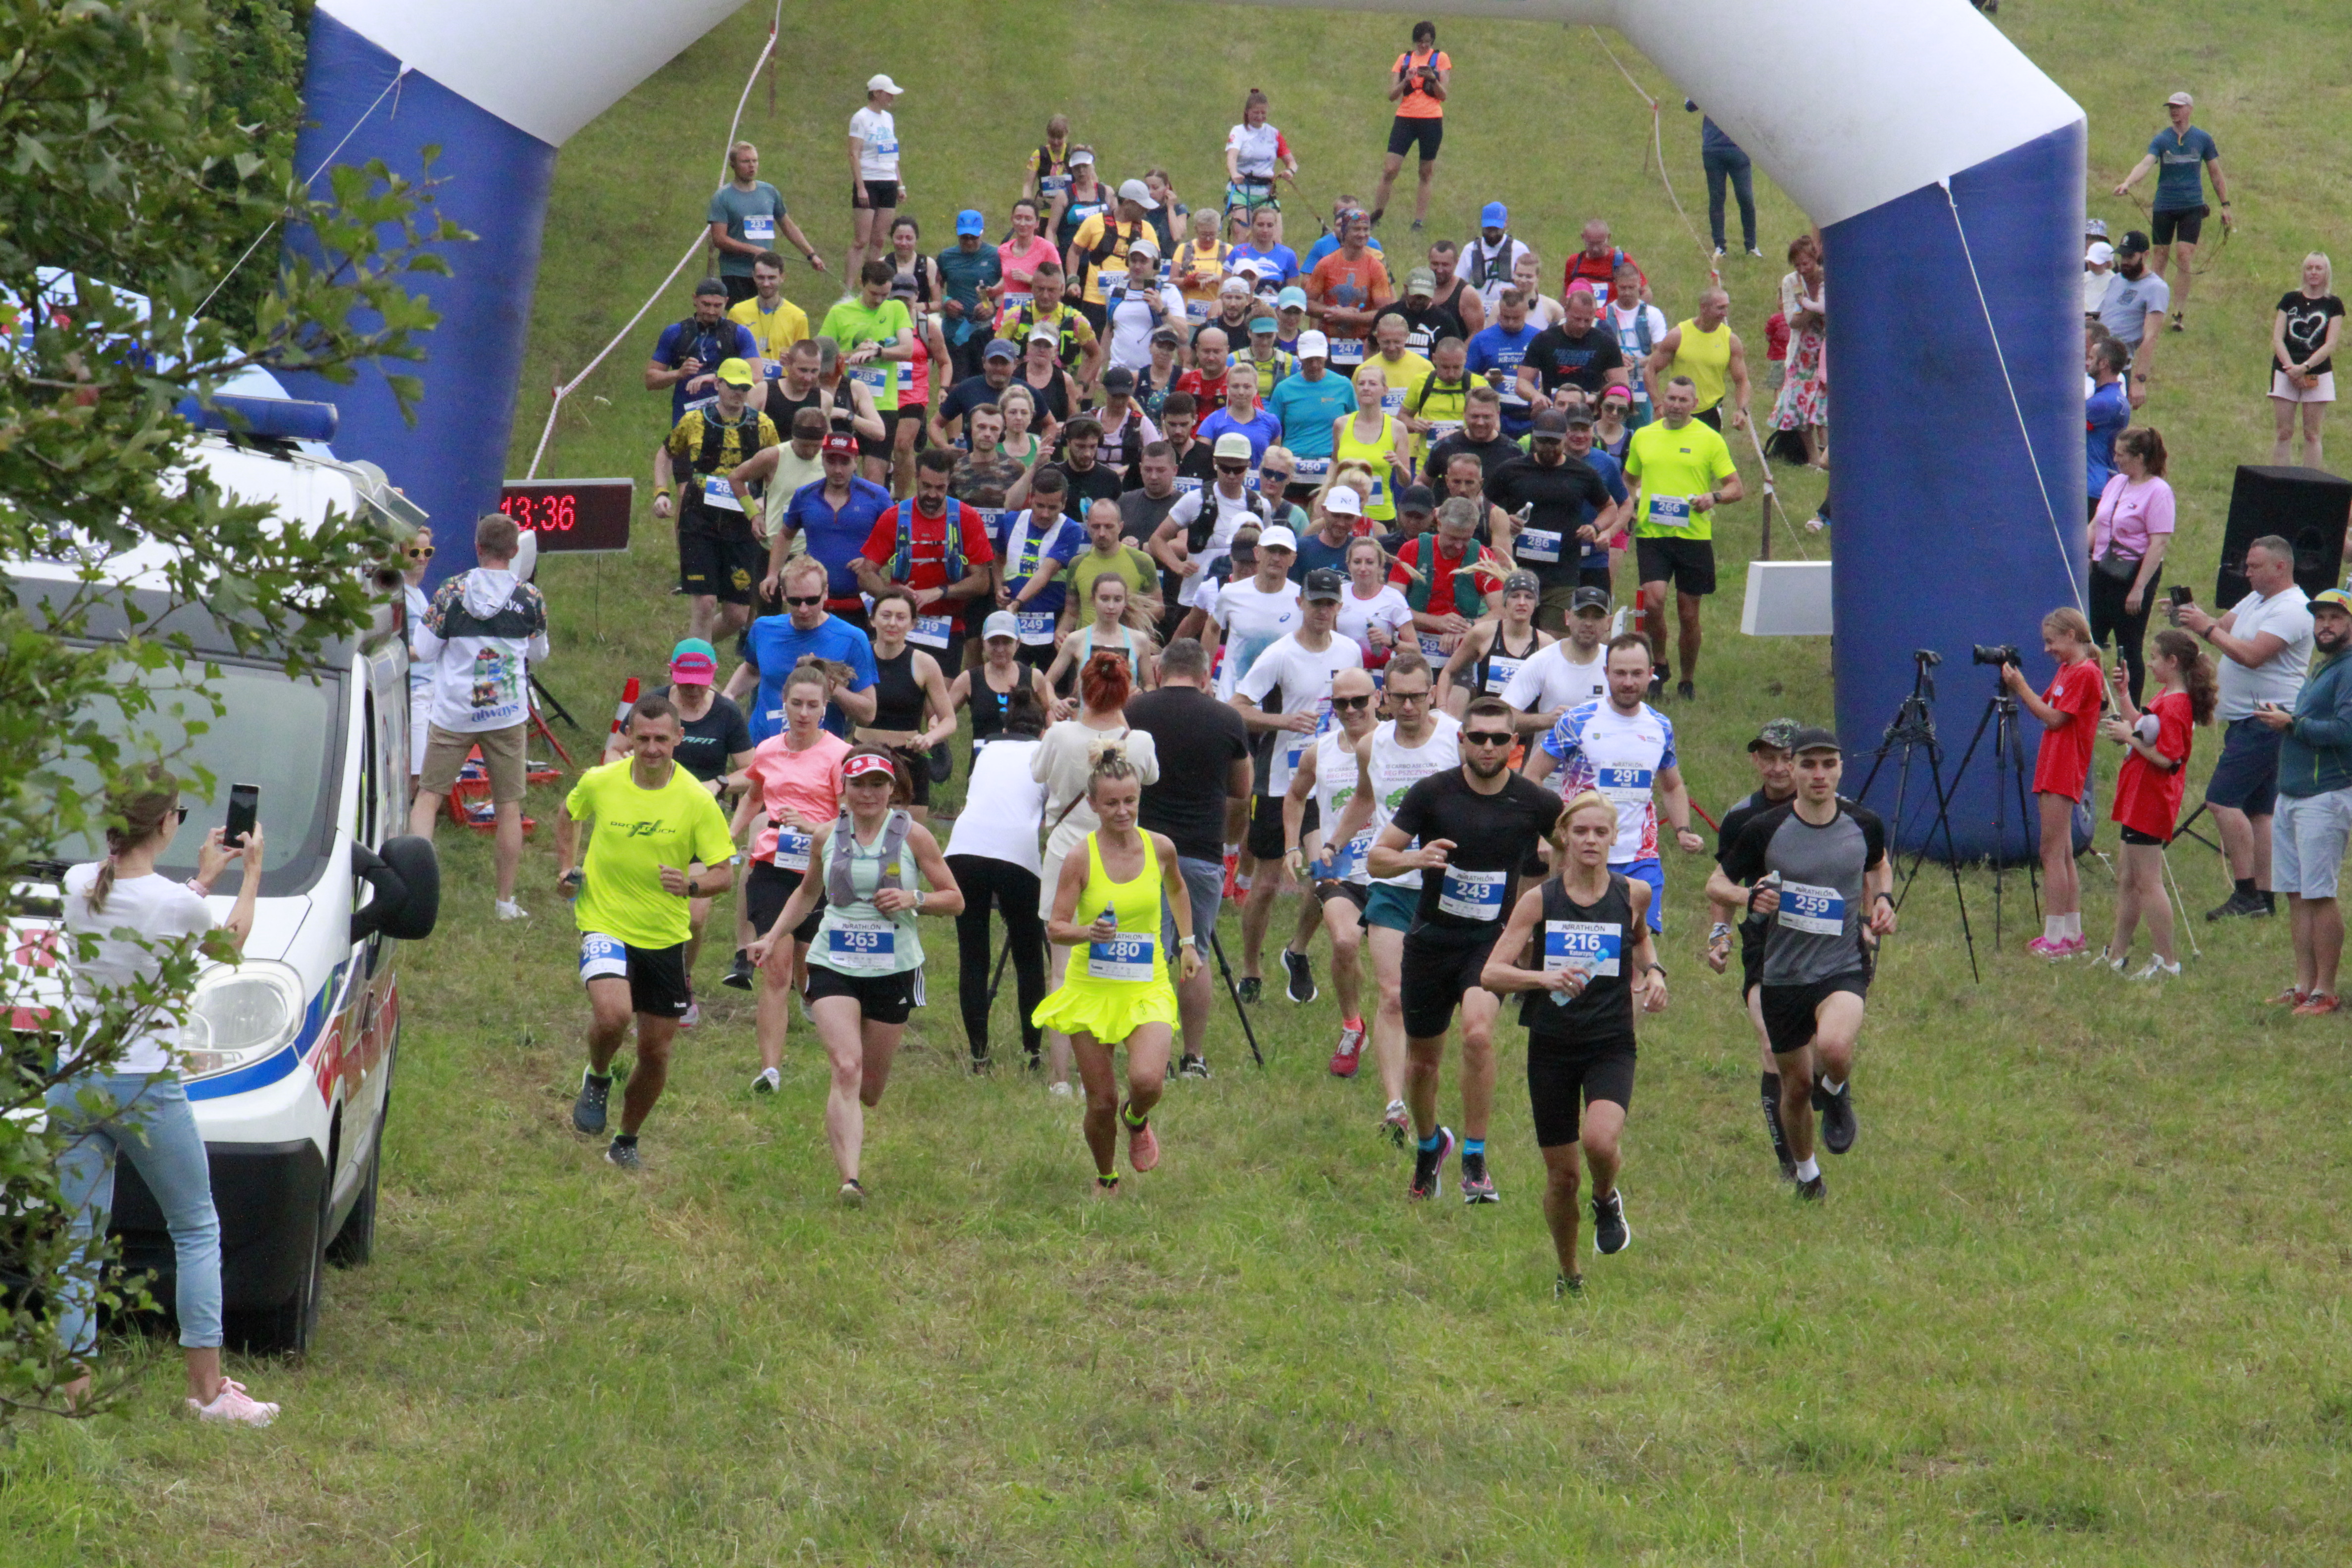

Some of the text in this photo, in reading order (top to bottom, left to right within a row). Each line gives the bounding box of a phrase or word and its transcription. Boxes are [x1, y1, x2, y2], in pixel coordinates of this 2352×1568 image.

[857, 372, 877, 383] 285
[1505, 383, 1516, 392] 22
[715, 482, 731, 494] 26
[1658, 502, 1680, 512] 266
[982, 515, 996, 524] 40
[1527, 536, 1550, 547] 286
[918, 620, 939, 632] 219
[1021, 619, 1044, 630] 249
[1422, 640, 1437, 652] 29
[1500, 667, 1516, 679] 22
[471, 703, 519, 723] always
[782, 718, 790, 730] 2
[682, 736, 716, 744] AFIT
[1613, 770, 1639, 783] 291
[791, 836, 811, 851] 22
[1351, 838, 1372, 854] 22
[1457, 873, 1494, 882] JURATHLON
[1456, 882, 1490, 899] 243
[1795, 886, 1834, 897] JURATHLON
[1795, 894, 1829, 913] 259
[1562, 923, 1606, 932] JURATHLON
[844, 931, 878, 947] 263
[1564, 933, 1601, 950] 216
[583, 941, 612, 961] 269
